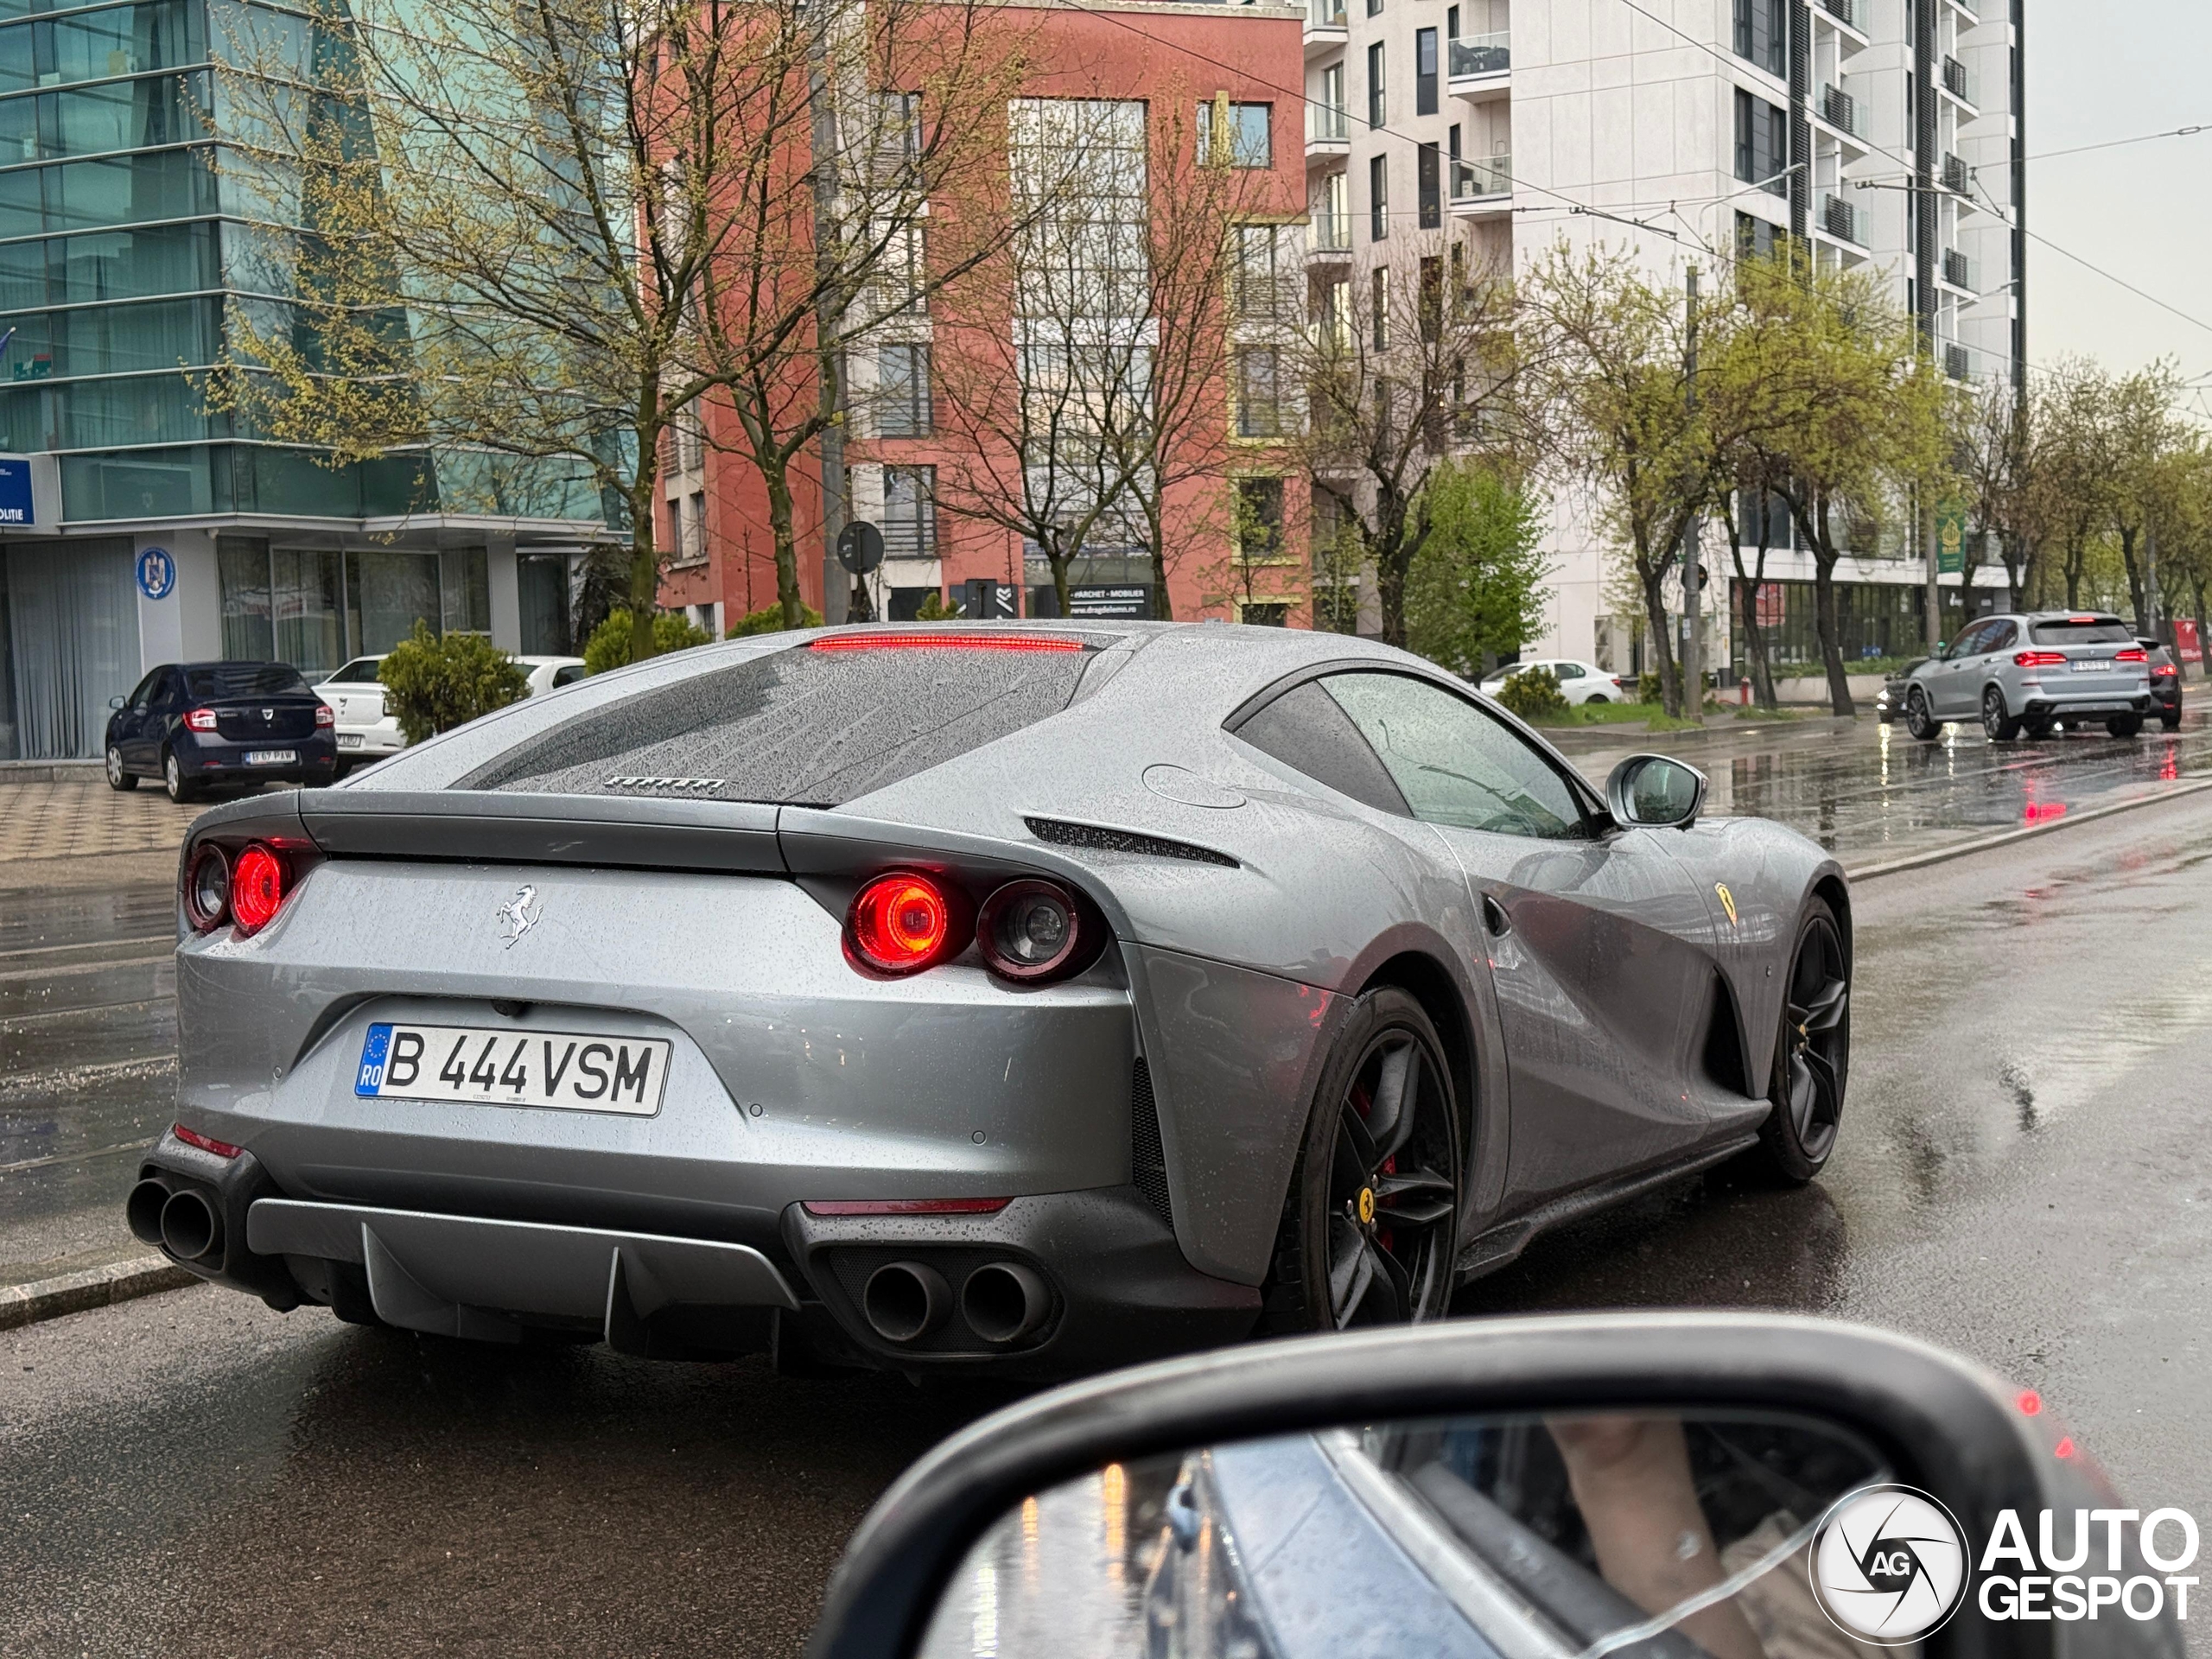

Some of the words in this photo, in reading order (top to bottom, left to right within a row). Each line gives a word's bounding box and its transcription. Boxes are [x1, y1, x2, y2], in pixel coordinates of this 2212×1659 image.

[359, 1064, 383, 1087] RO
[385, 1032, 425, 1086] B
[439, 1035, 529, 1094] 444
[543, 1039, 653, 1103] VSM
